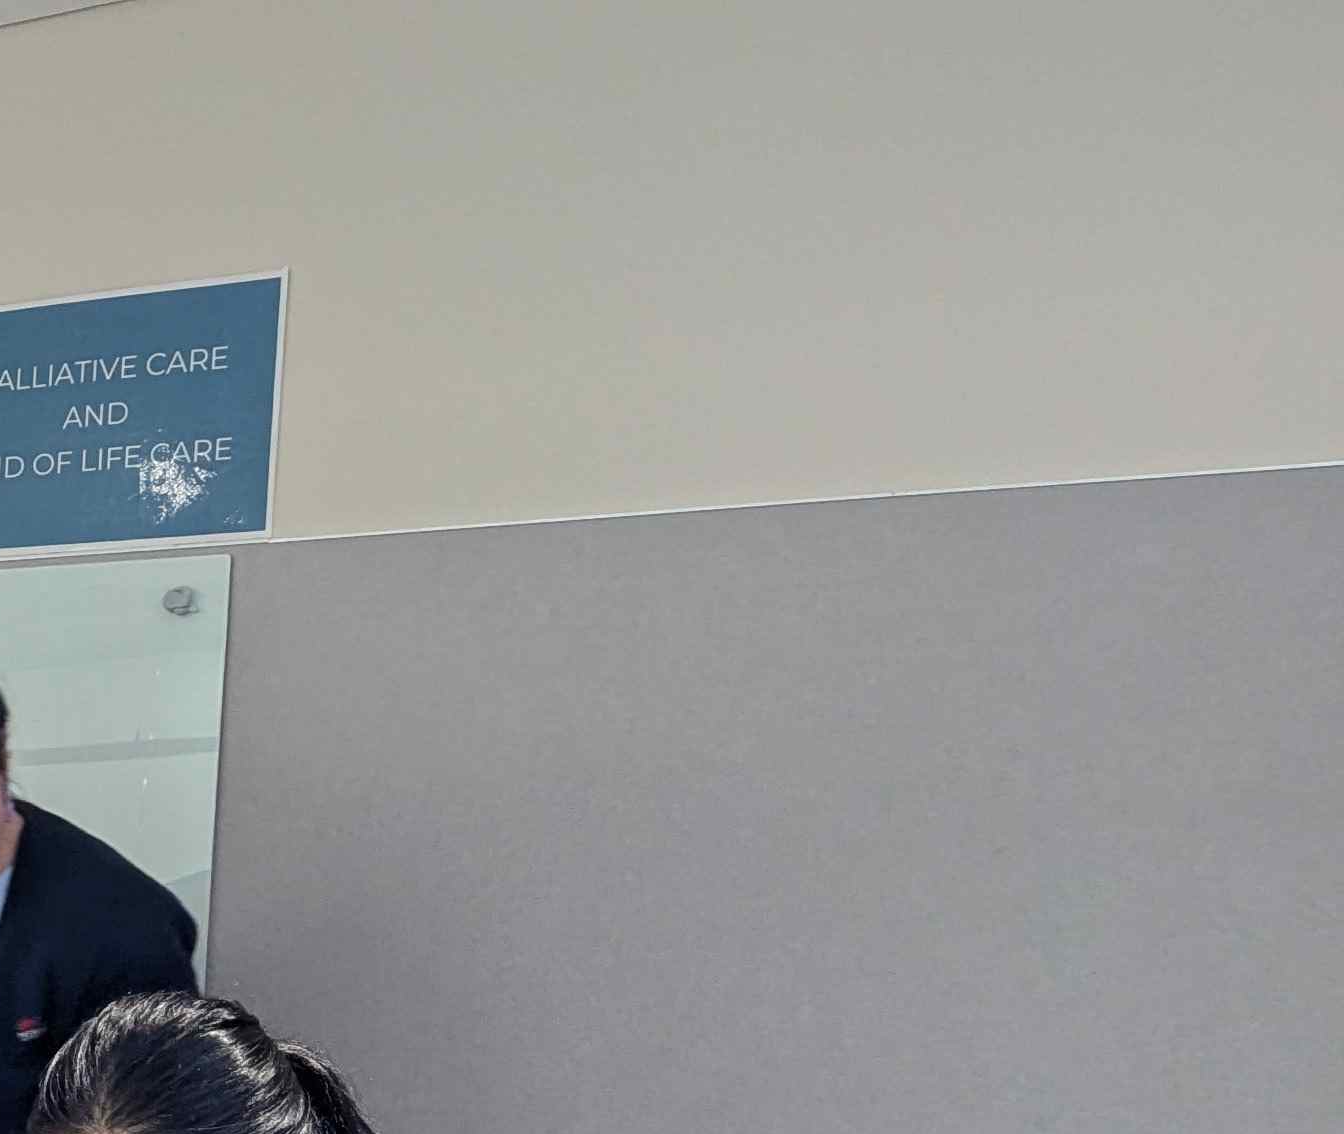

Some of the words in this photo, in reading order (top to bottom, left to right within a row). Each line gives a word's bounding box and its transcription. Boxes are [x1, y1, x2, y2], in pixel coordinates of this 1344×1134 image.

[146, 345, 229, 376] CARE
[62, 401, 129, 430] AND
[32, 451, 73, 476] OF
[81, 444, 142, 472] LIFE
[150, 437, 233, 464] CARE
